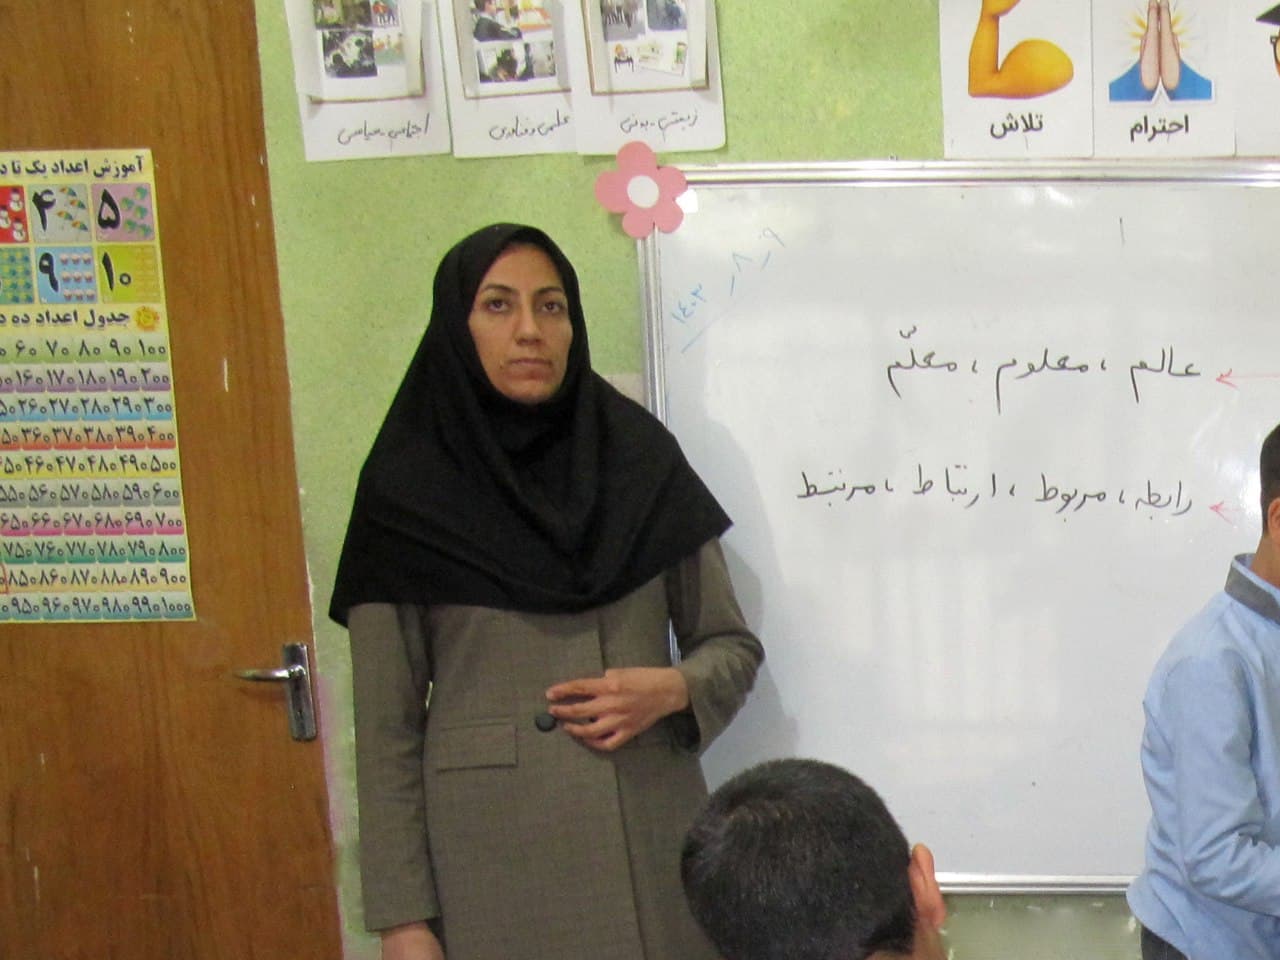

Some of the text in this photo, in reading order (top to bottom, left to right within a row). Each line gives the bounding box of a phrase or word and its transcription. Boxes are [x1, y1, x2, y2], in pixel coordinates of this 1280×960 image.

[989, 112, 1045, 139] تلاش
[1129, 113, 1189, 142] احترام
[25, 160, 47, 179] یک
[51, 158, 89, 174] اعداد
[93, 155, 145, 179] آموزش
[32, 188, 121, 232] ۴ ۵
[38, 251, 132, 292] ۹ ۱۰
[11, 312, 30, 325] ده
[35, 310, 78, 325] اعداد
[83, 309, 130, 328] جدول
